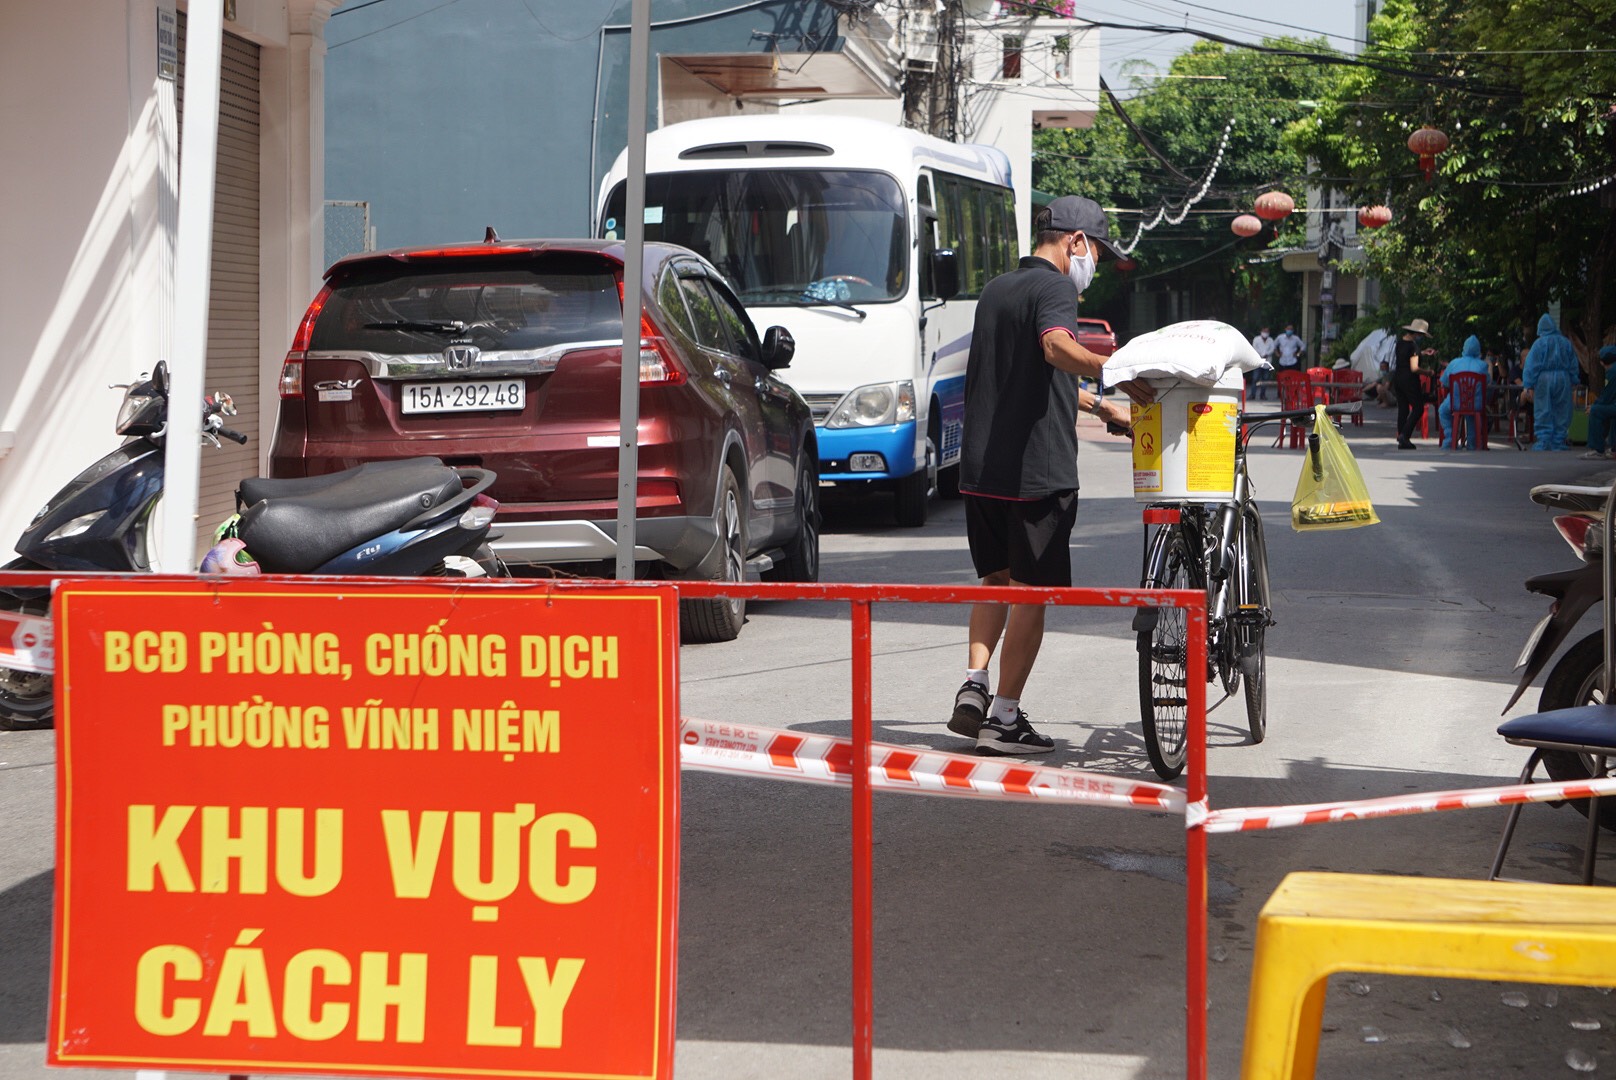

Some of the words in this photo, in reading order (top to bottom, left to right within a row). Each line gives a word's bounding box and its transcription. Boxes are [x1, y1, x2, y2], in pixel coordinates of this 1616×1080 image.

[409, 383, 520, 409] 15A-292.48
[104, 630, 188, 673] BCĐ
[200, 621, 353, 680] PHÒNG,
[365, 618, 507, 678] CHỐNG
[520, 634, 618, 688] DỊCH
[162, 695, 330, 749] PHƯỜNG
[341, 699, 439, 751] VĨNH
[452, 700, 560, 762] NIỆM
[127, 804, 344, 898] KHU
[380, 802, 598, 922] VỰC
[134, 927, 429, 1044] CÁCH
[465, 954, 587, 1049] LY
